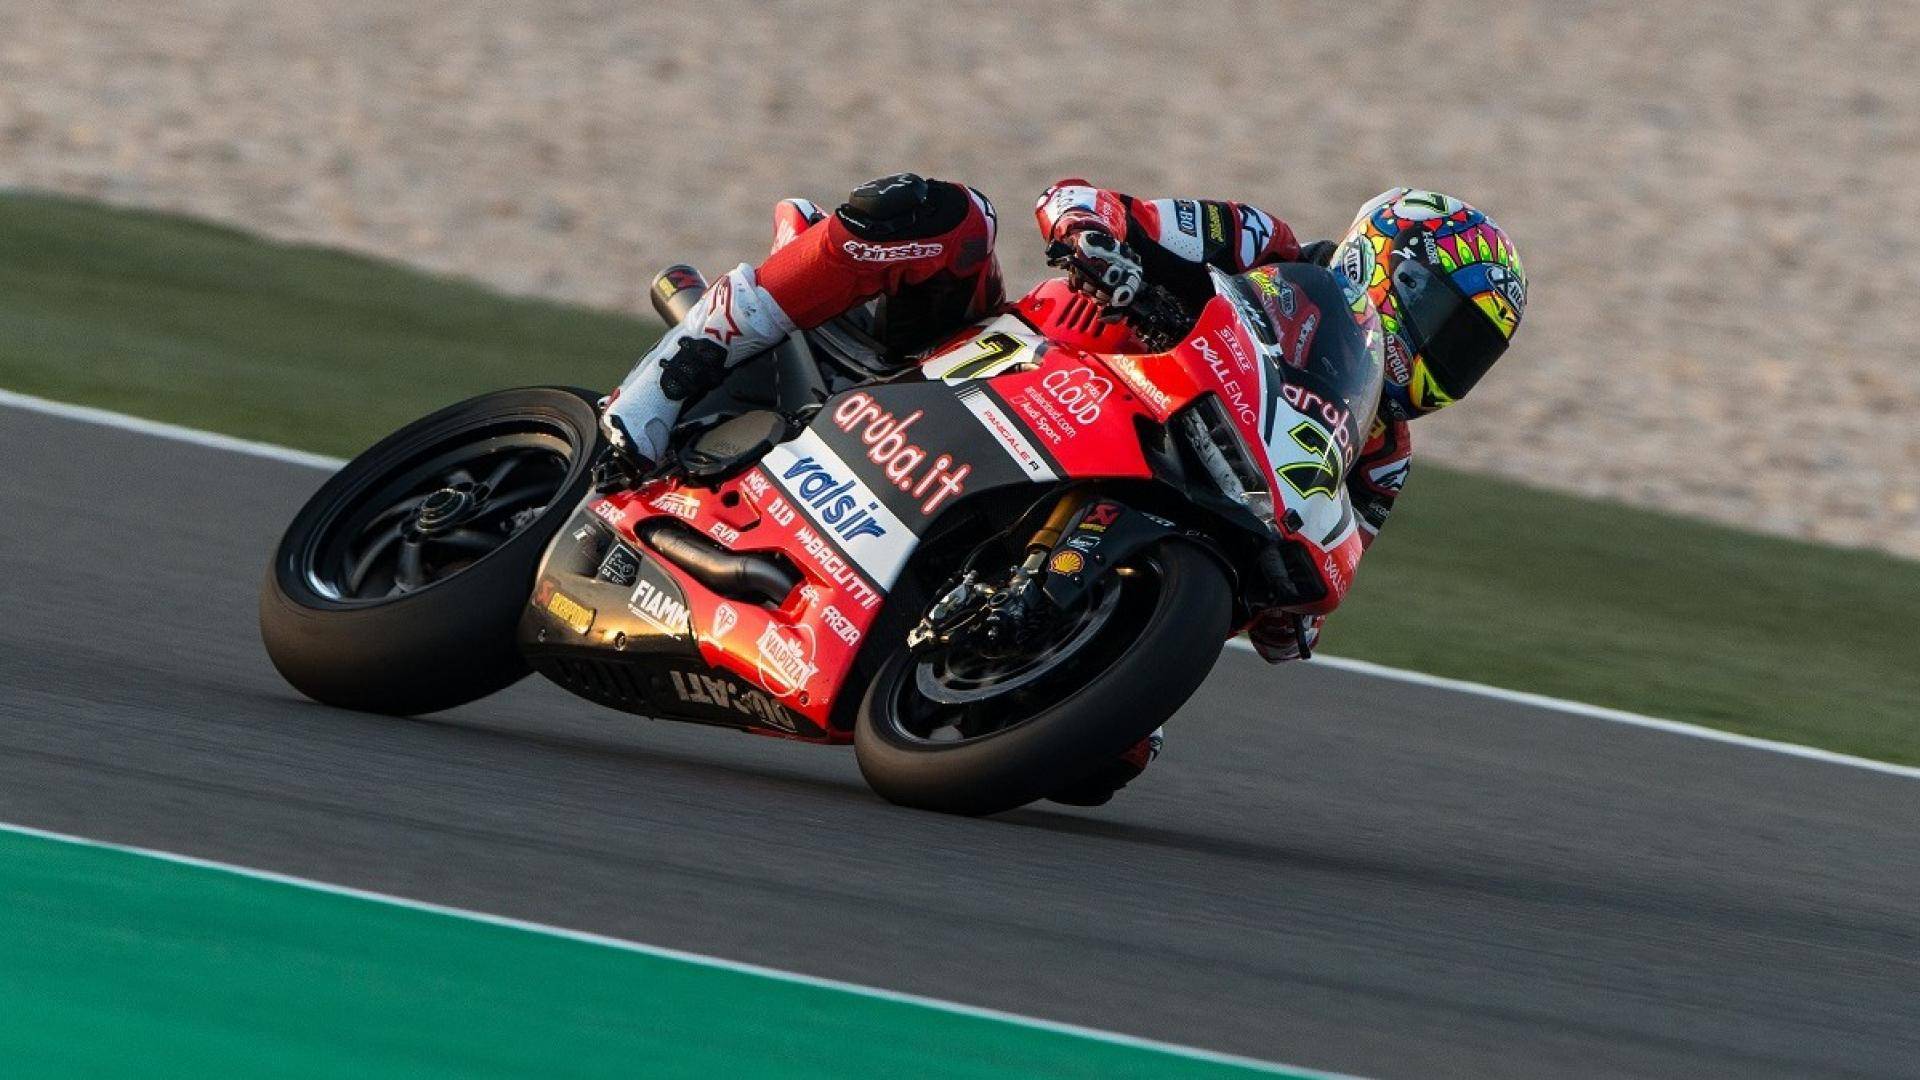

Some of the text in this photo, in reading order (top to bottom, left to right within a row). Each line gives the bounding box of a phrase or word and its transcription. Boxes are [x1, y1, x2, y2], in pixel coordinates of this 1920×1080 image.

[1402, 192, 1449, 217] 7
[941, 331, 1028, 380] 7
[1042, 370, 1101, 425] CLOUD
[833, 392, 972, 515] aruba.it
[1036, 417, 1062, 444] Sport
[745, 470, 771, 498] NGK
[1276, 421, 1342, 500] 7
[784, 456, 887, 542] valsir
[631, 579, 690, 634] FIAMM
